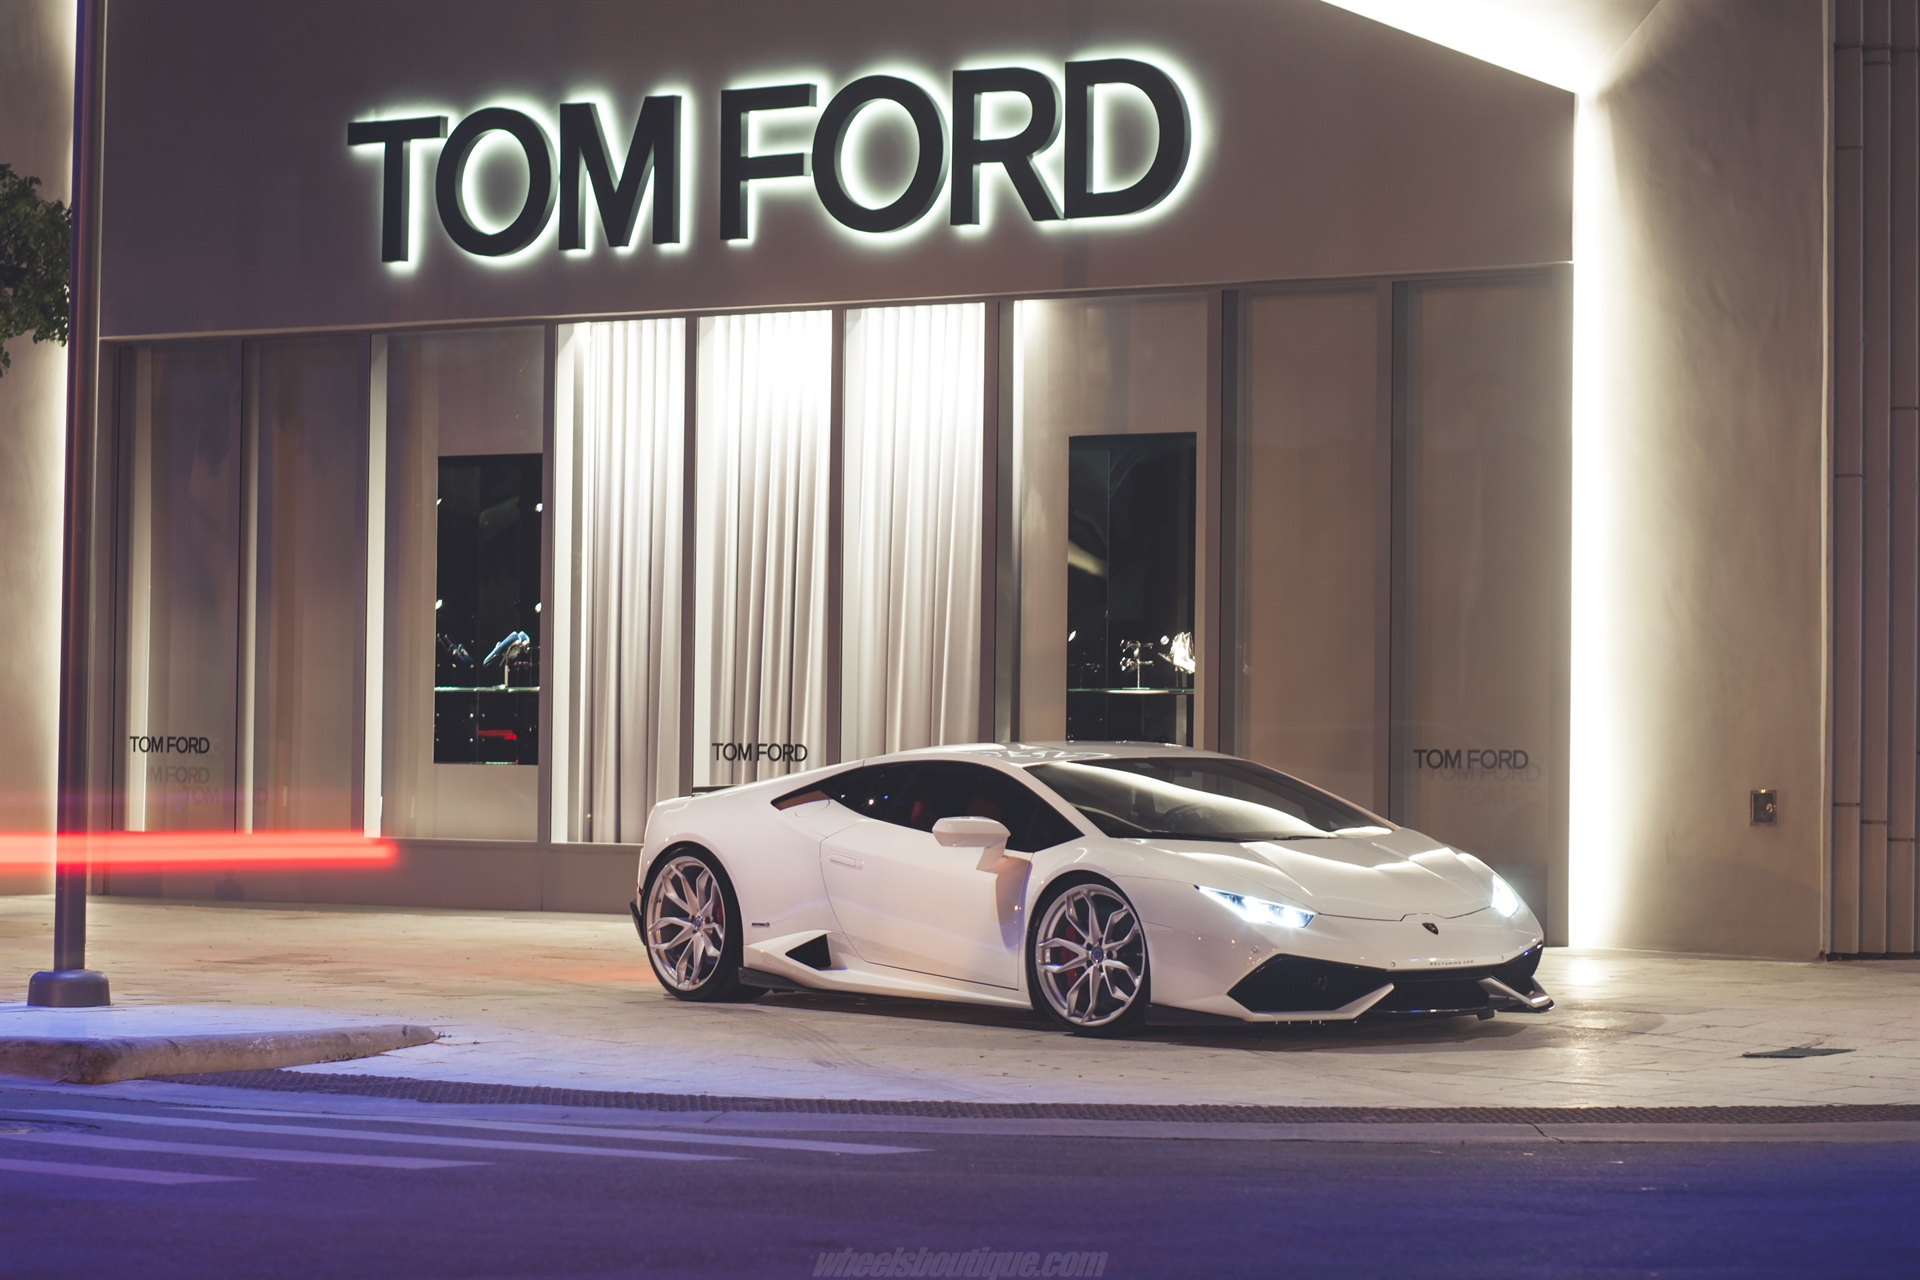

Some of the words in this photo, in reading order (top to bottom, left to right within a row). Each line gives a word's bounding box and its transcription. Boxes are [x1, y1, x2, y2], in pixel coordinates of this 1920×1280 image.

[347, 94, 683, 263] TOM
[720, 57, 1192, 240] FORD
[129, 736, 164, 754] TOM
[166, 736, 210, 754] FORD
[712, 742, 752, 761] TOM
[757, 743, 808, 762] FORD
[1413, 749, 1462, 770] TOM
[1467, 749, 1529, 770] FORD
[165, 766, 210, 784] FORD
